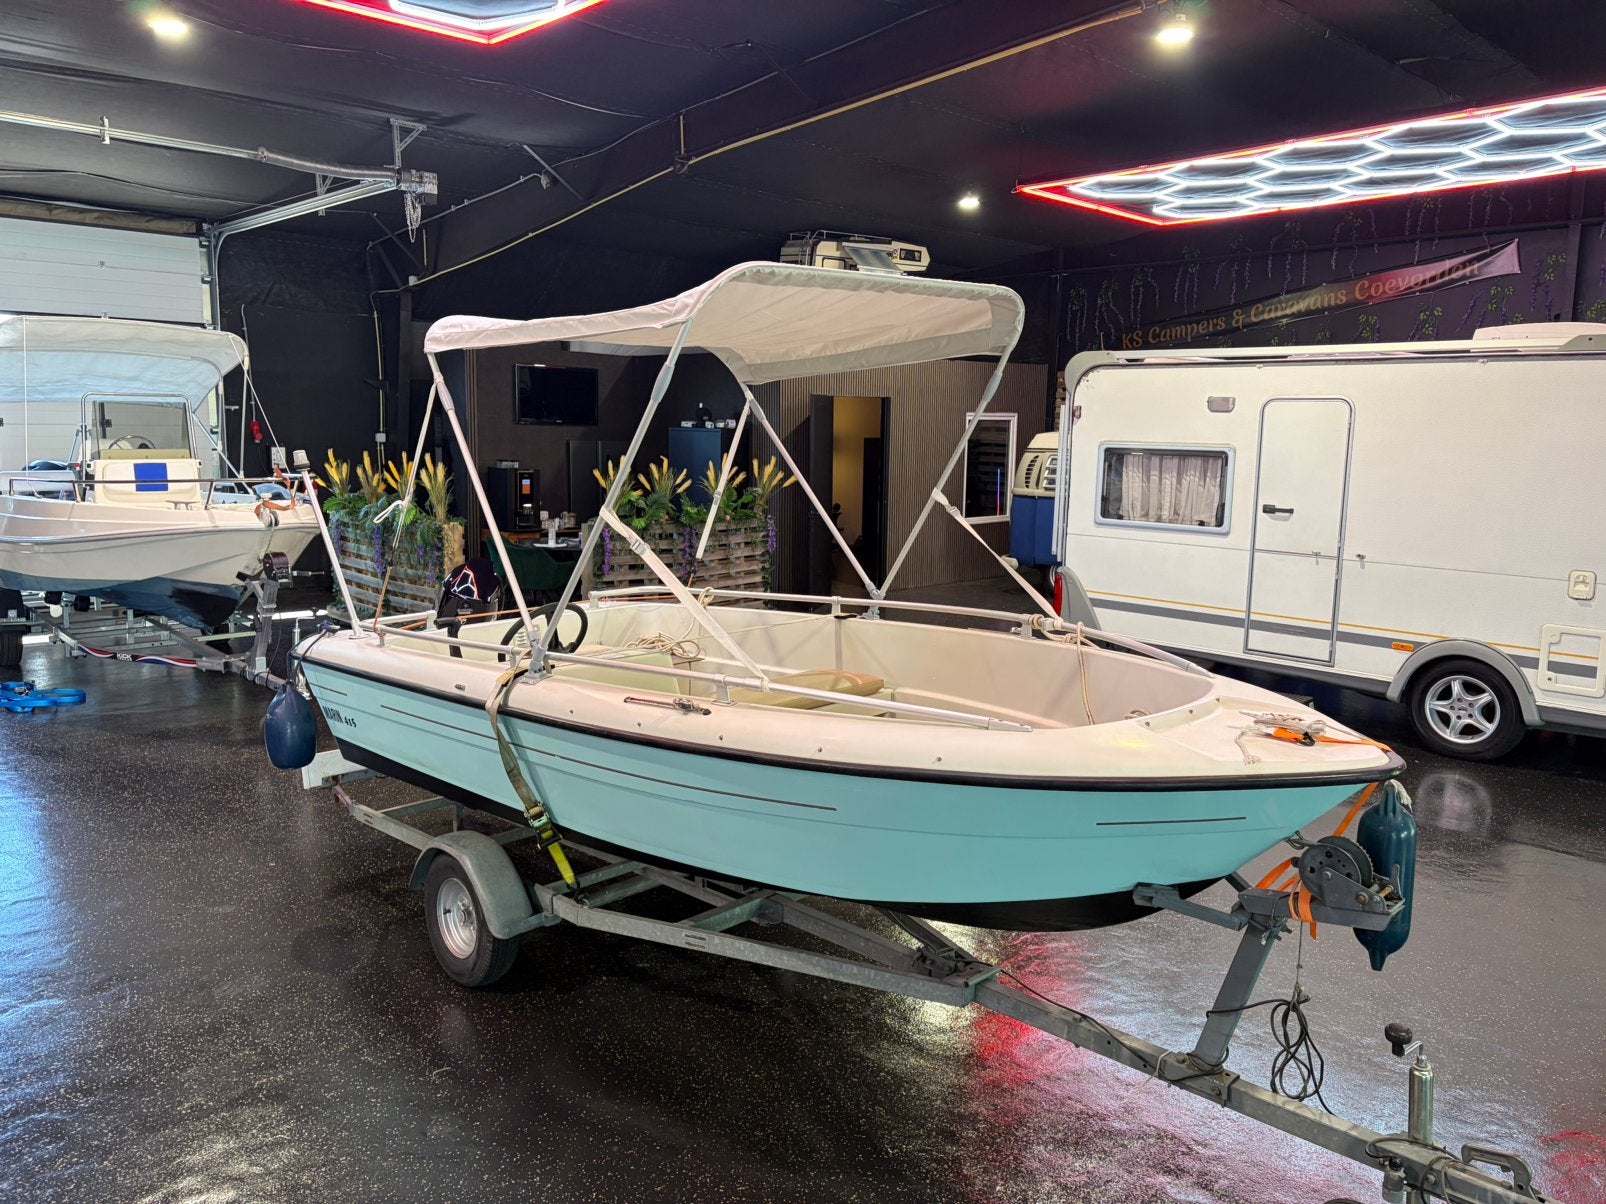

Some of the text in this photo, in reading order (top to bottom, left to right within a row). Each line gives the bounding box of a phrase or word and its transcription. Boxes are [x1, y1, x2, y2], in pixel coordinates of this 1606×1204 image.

[1122, 259, 1480, 349] KS Campers & Caravans Coevorden
